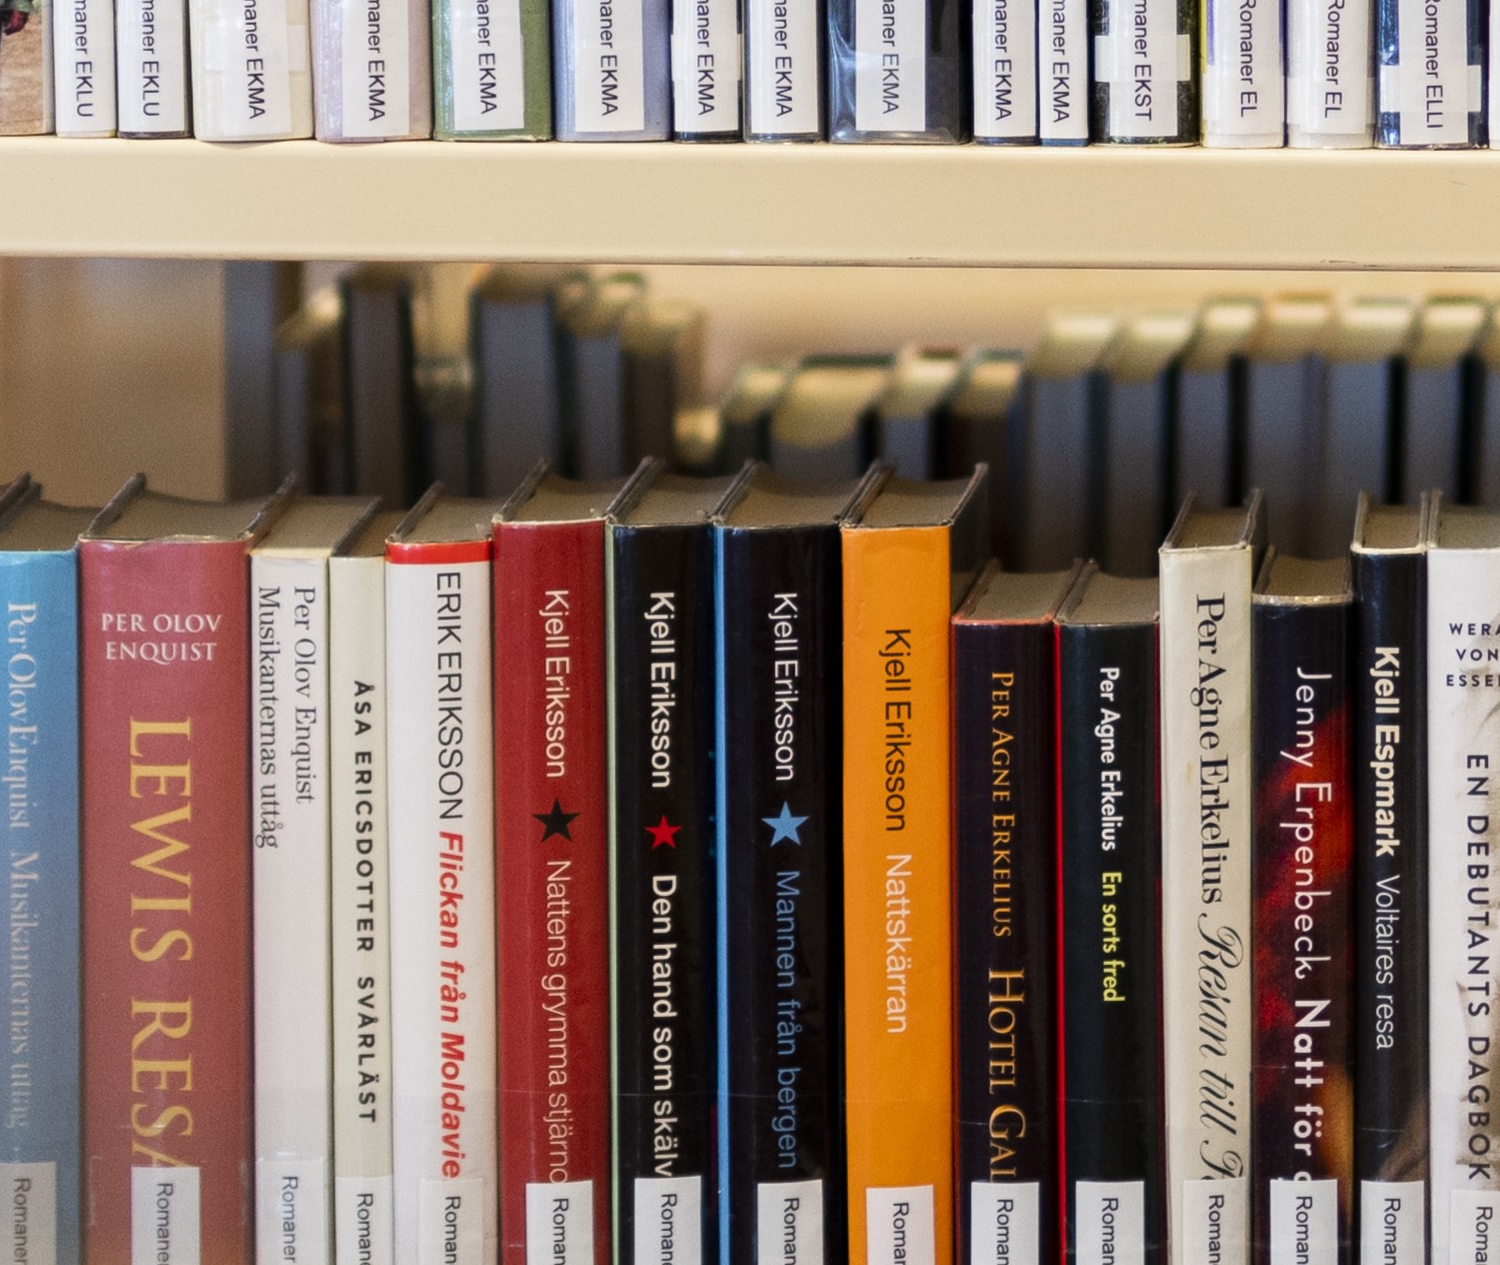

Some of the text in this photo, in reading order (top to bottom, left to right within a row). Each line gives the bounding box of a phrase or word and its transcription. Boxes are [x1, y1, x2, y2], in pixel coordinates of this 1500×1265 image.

[142, 61, 159, 117] EKLU
[479, 53, 497, 114] EKMA
[1135, 65, 1151, 121] EKST
[1426, 85, 1443, 128] ELLI
[256, 586, 283, 848] Musikanternas uttåg
[292, 587, 317, 804] Per Olov Enquist
[437, 572, 465, 1023] ERIK ERIKSSON Flickan från
[1190, 593, 1230, 904] Per Agne Erkelius
[1455, 649, 1499, 661] VON
[129, 716, 193, 962] LEWIS
[354, 680, 379, 1124] ÅSA ERICSDOTTER SVÅRLÄST
[539, 589, 572, 1087] Kjell Eriksson Nattens grymma
[767, 593, 801, 1168] Kjell Eriksson Mannen från bergen
[879, 629, 912, 1034] Kjell Eriksson Nattskärran
[1095, 667, 1125, 1002] Per Agne Erkelius En sorts fred
[1280, 667, 1332, 1156] Jenny Erpenbeck Natt för
[1370, 646, 1400, 1050] Kjell Espmark Voltaires resa
[1467, 754, 1491, 1180] EN DEBUTANTS DAGBOK
